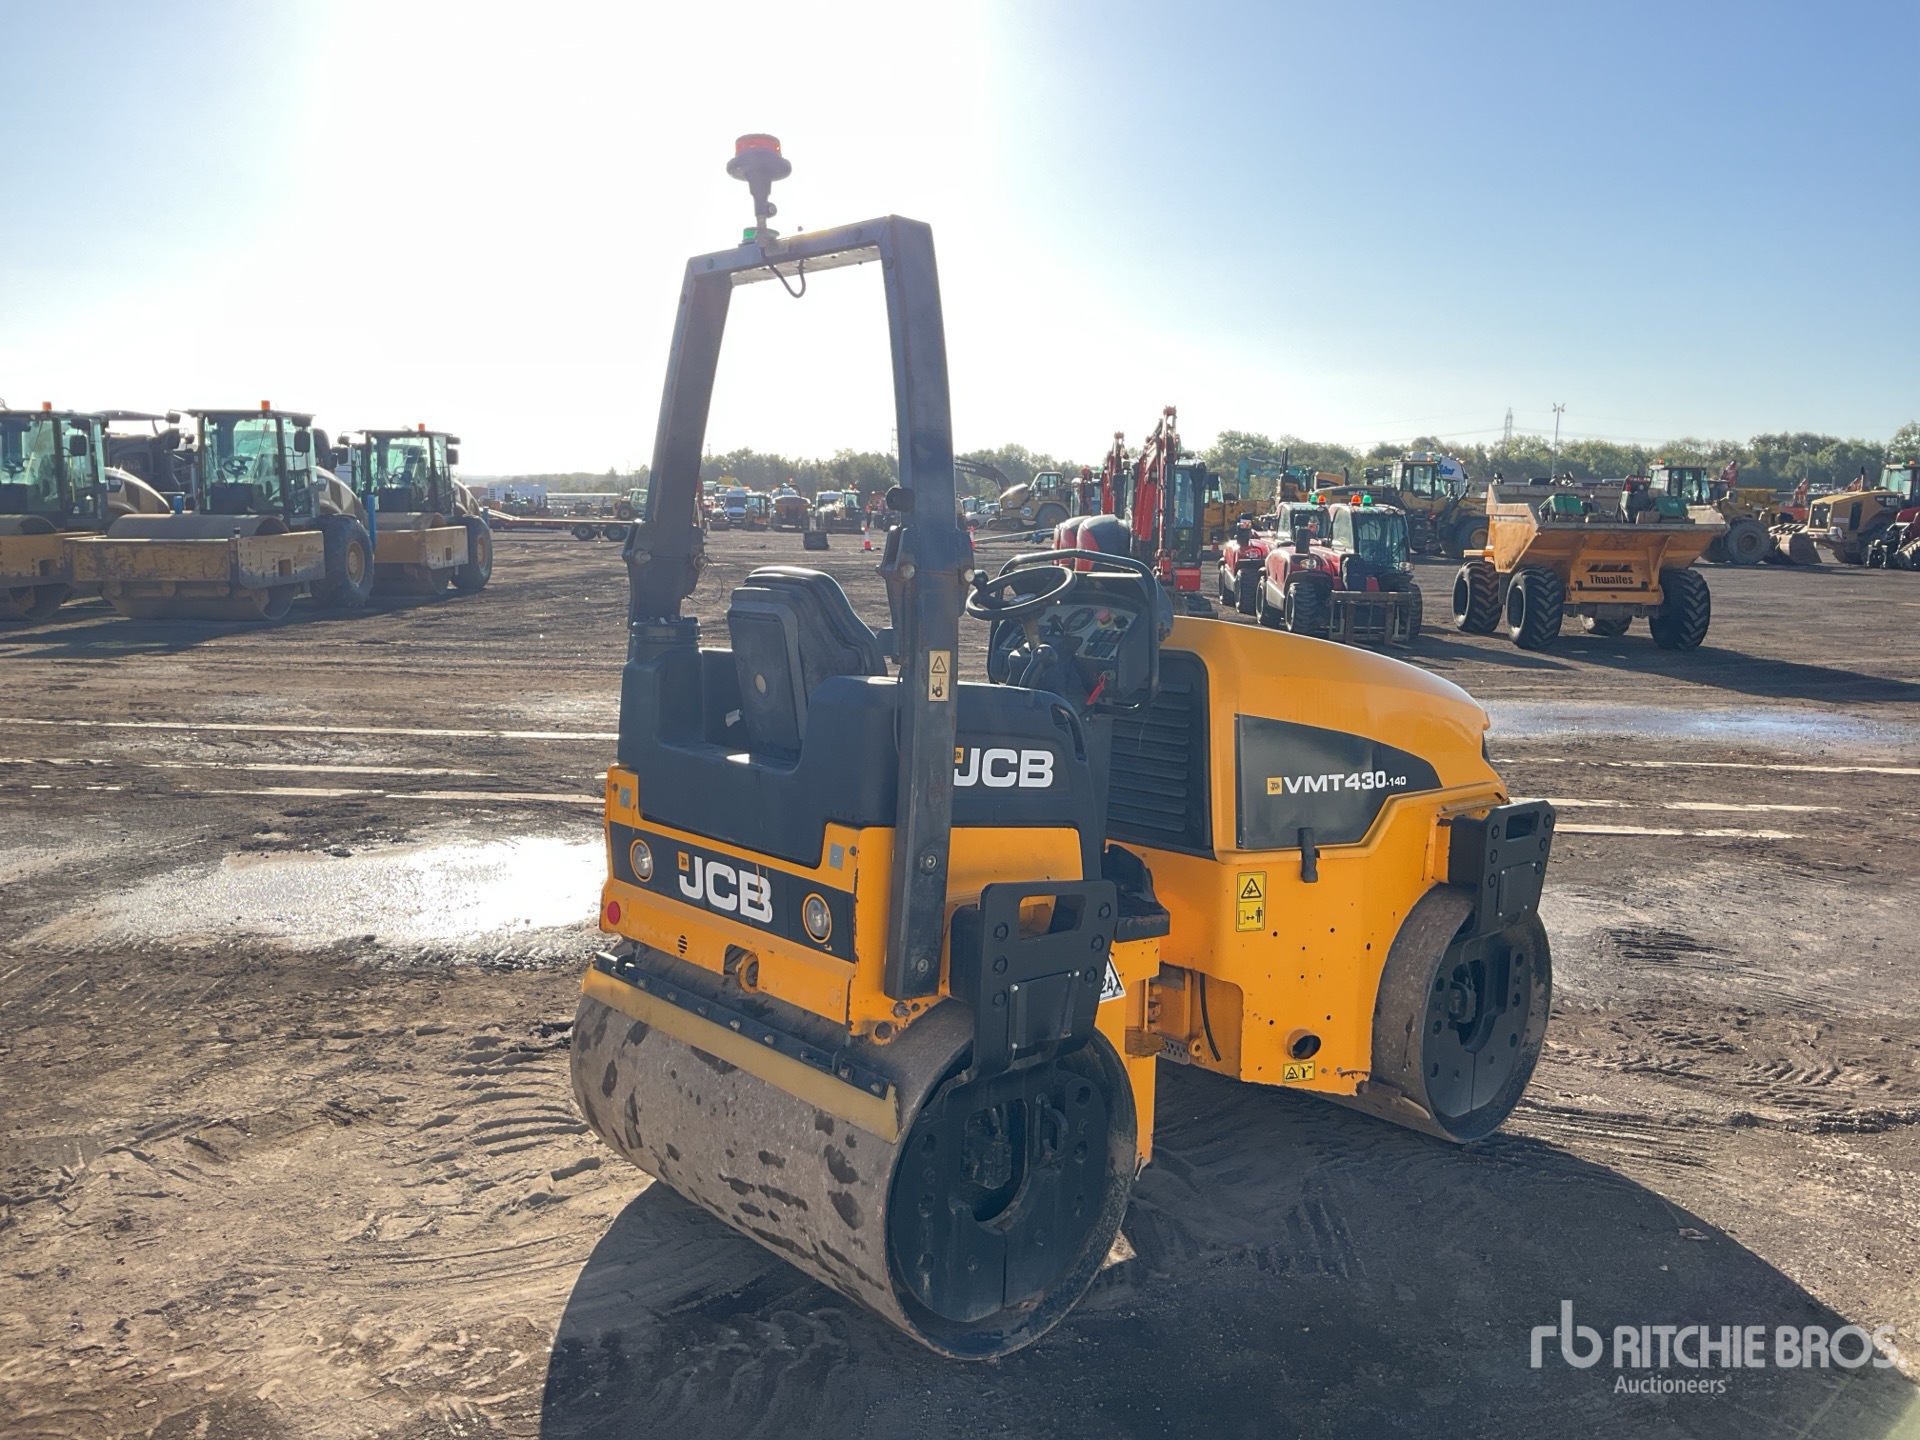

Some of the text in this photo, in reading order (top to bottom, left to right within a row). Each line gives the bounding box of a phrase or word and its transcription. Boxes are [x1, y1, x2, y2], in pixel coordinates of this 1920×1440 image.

[1886, 497, 1898, 506] CAT
[1590, 575, 1633, 584] Thwaites
[953, 748, 1054, 787] JCB
[678, 856, 773, 924] JCB
